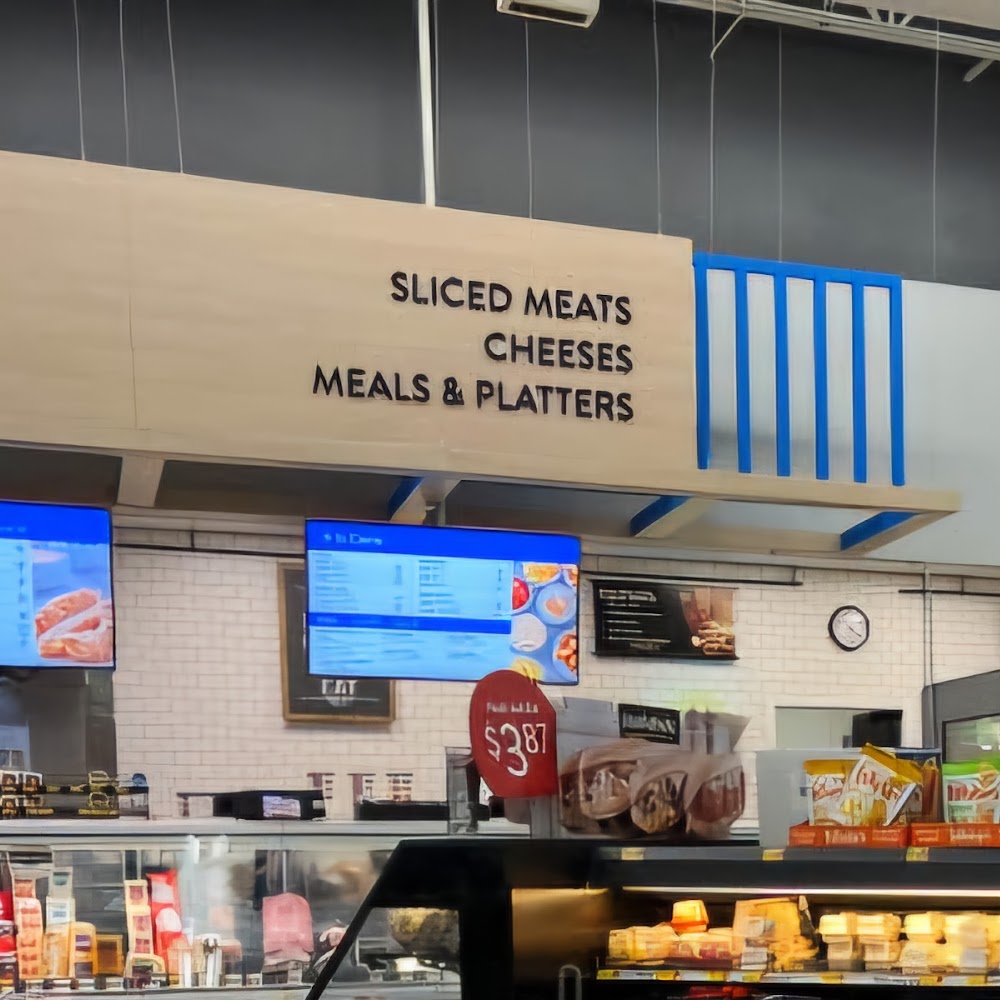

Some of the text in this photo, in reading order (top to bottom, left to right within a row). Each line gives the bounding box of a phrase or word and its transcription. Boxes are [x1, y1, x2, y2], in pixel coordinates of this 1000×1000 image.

[391, 271, 632, 326] SLICED MEATS
[484, 332, 633, 376] CHEESES
[313, 364, 634, 423] MEALS & PLATTERS
